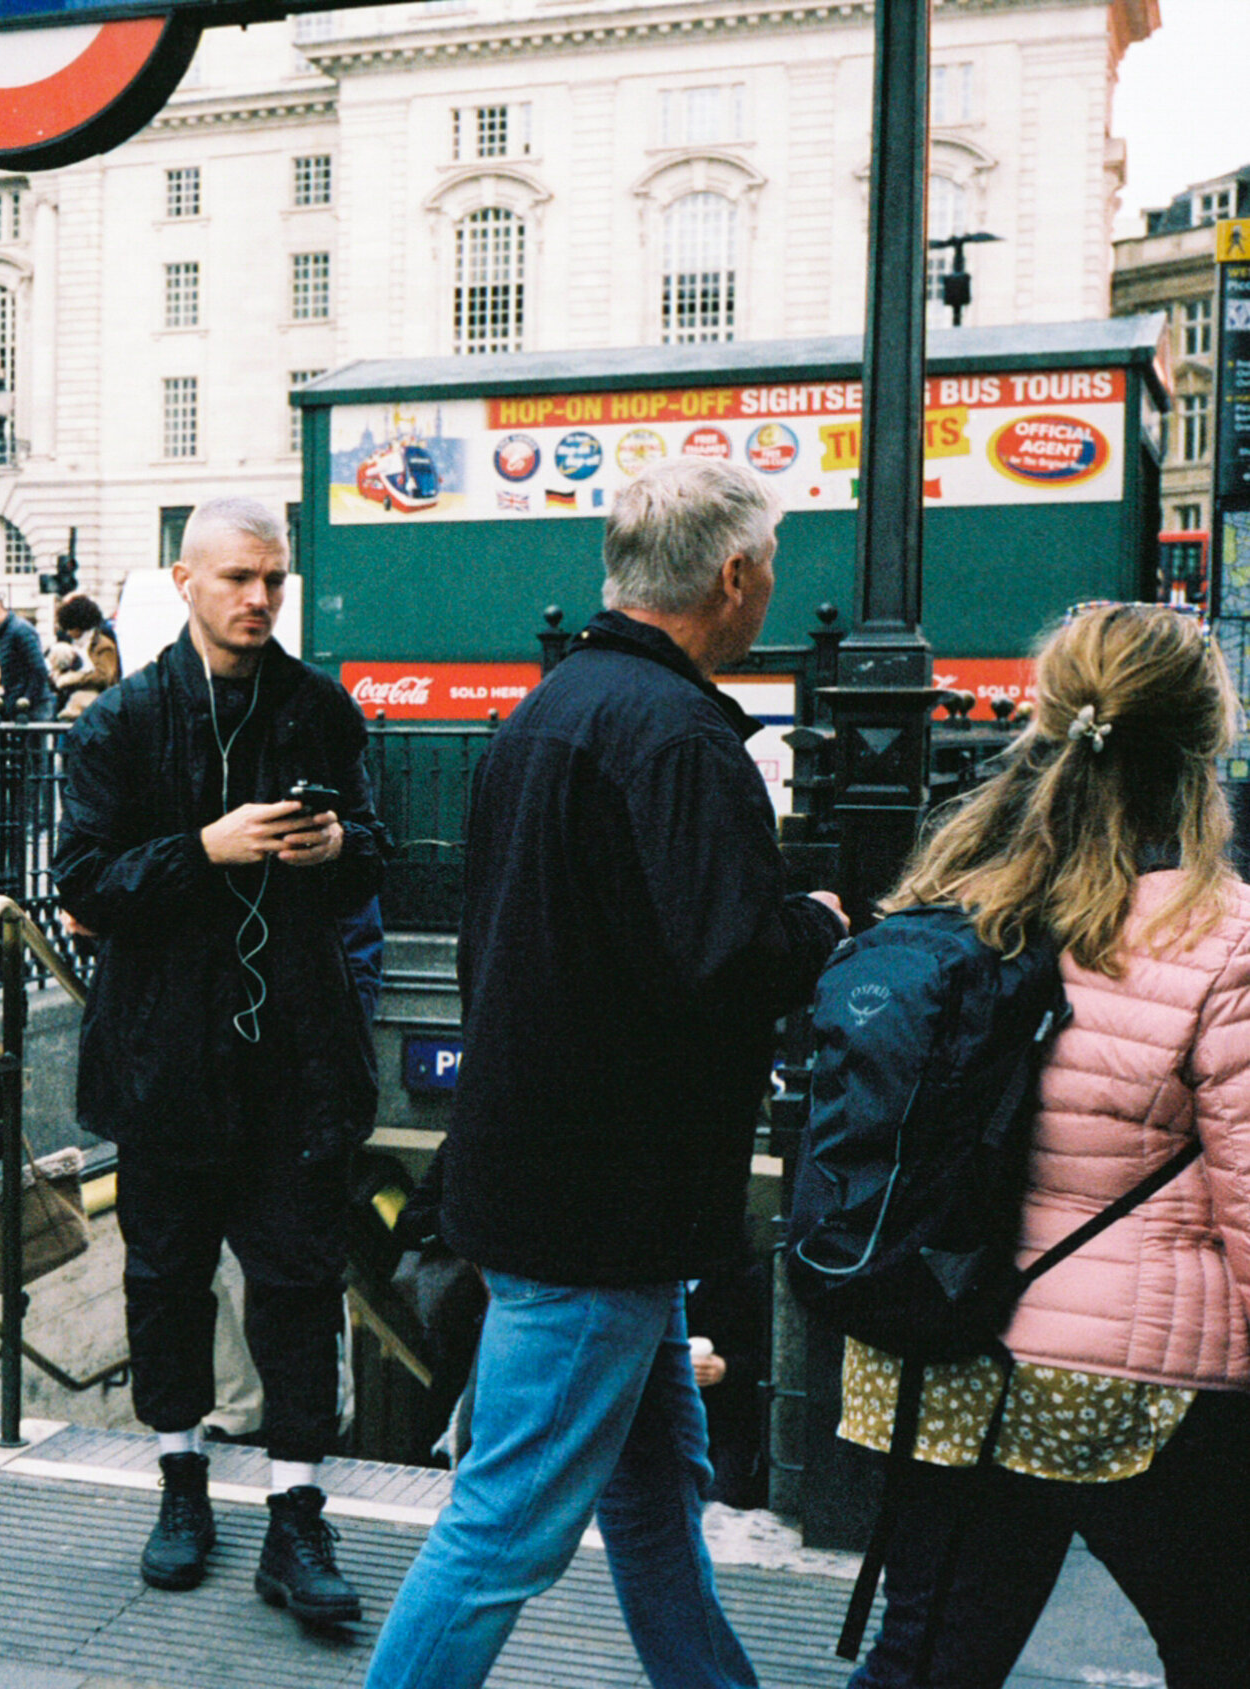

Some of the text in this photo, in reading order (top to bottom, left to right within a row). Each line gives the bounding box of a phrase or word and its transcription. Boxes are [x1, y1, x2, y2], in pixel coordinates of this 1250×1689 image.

[500, 371, 1113, 425] HOP-ON HOP-OFF SIGHTSE BUS TOURS
[828, 417, 960, 460] TITS
[1015, 422, 1093, 442] OFFICIAL
[1019, 439, 1083, 457] AGENT
[449, 686, 488, 699] SOLD
[490, 686, 528, 699] HERE
[977, 685, 1021, 698] SOLD
[851, 984, 892, 1000] OSPREY
